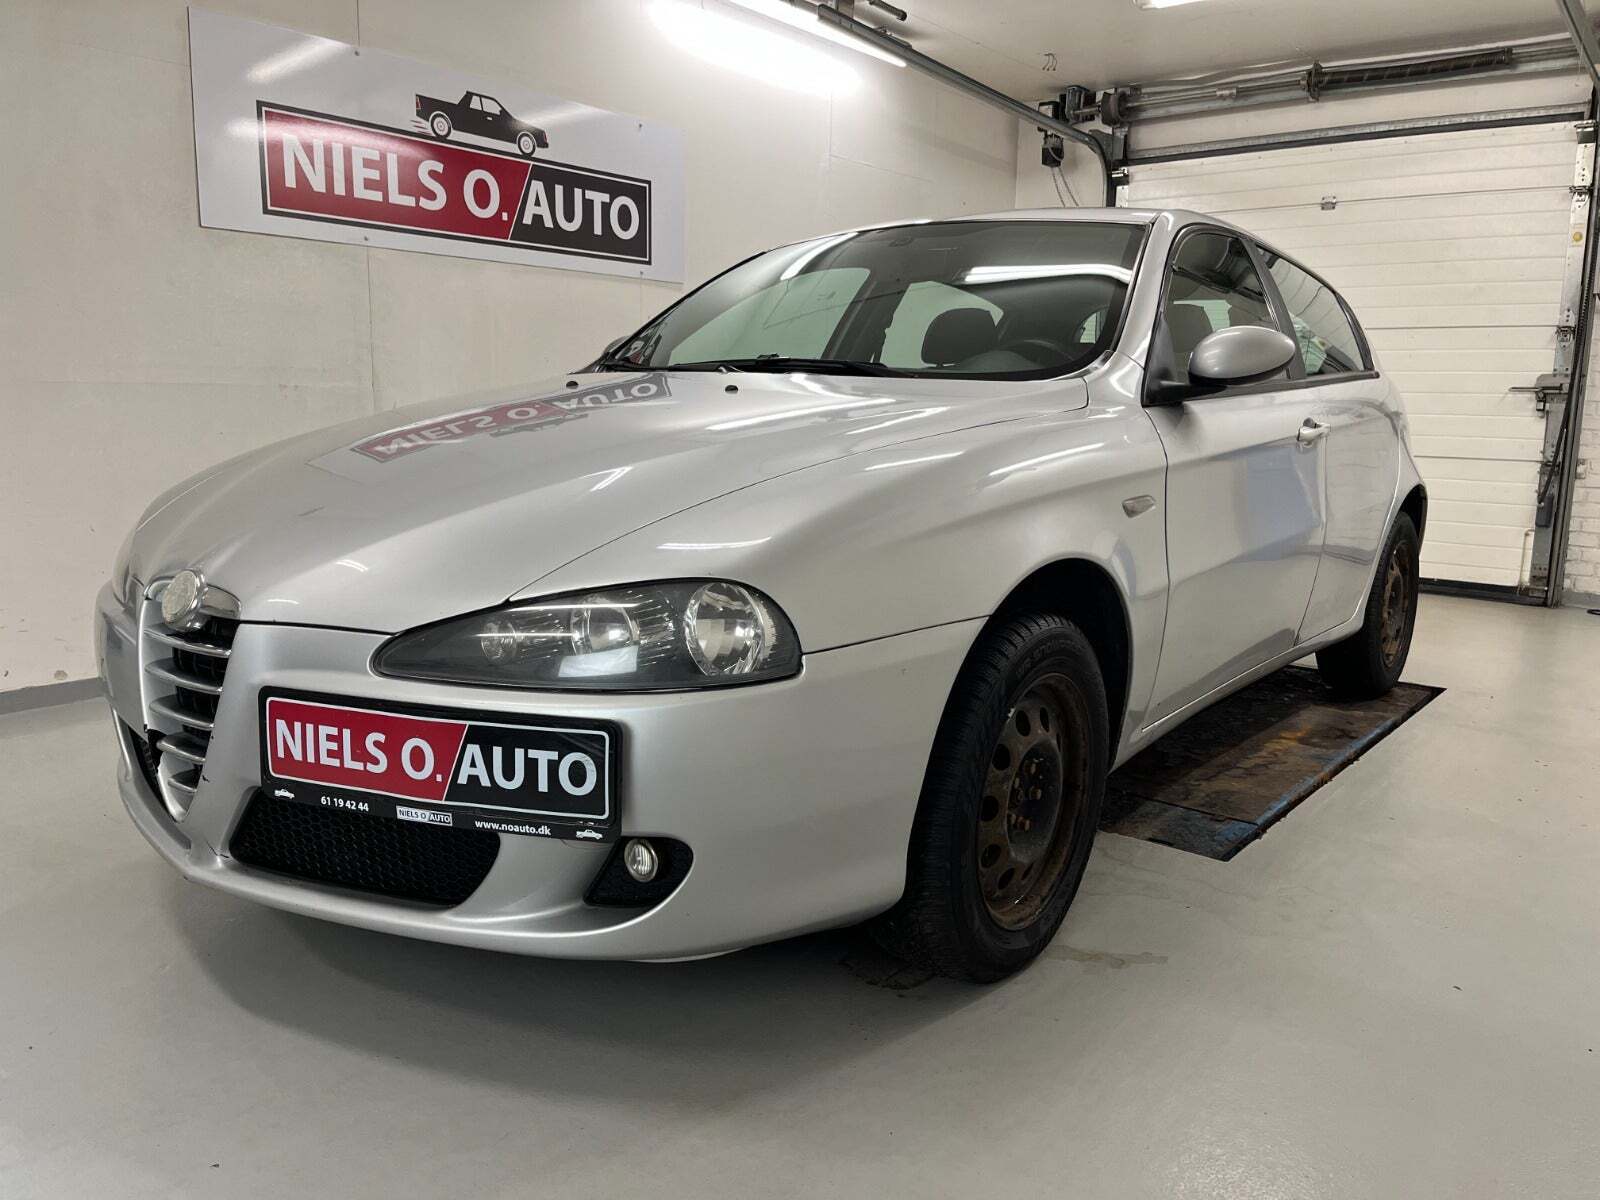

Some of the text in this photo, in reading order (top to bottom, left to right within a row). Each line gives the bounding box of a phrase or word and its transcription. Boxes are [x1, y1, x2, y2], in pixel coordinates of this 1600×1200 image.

[282, 136, 641, 241] NIELS O. AUTO
[275, 718, 598, 797] NIELS O. AUTO
[320, 796, 369, 812] 61 19 42 44
[399, 809, 419, 819] NIELS
[429, 813, 451, 824] AUTO
[475, 820, 551, 836] www.noauto.dk
